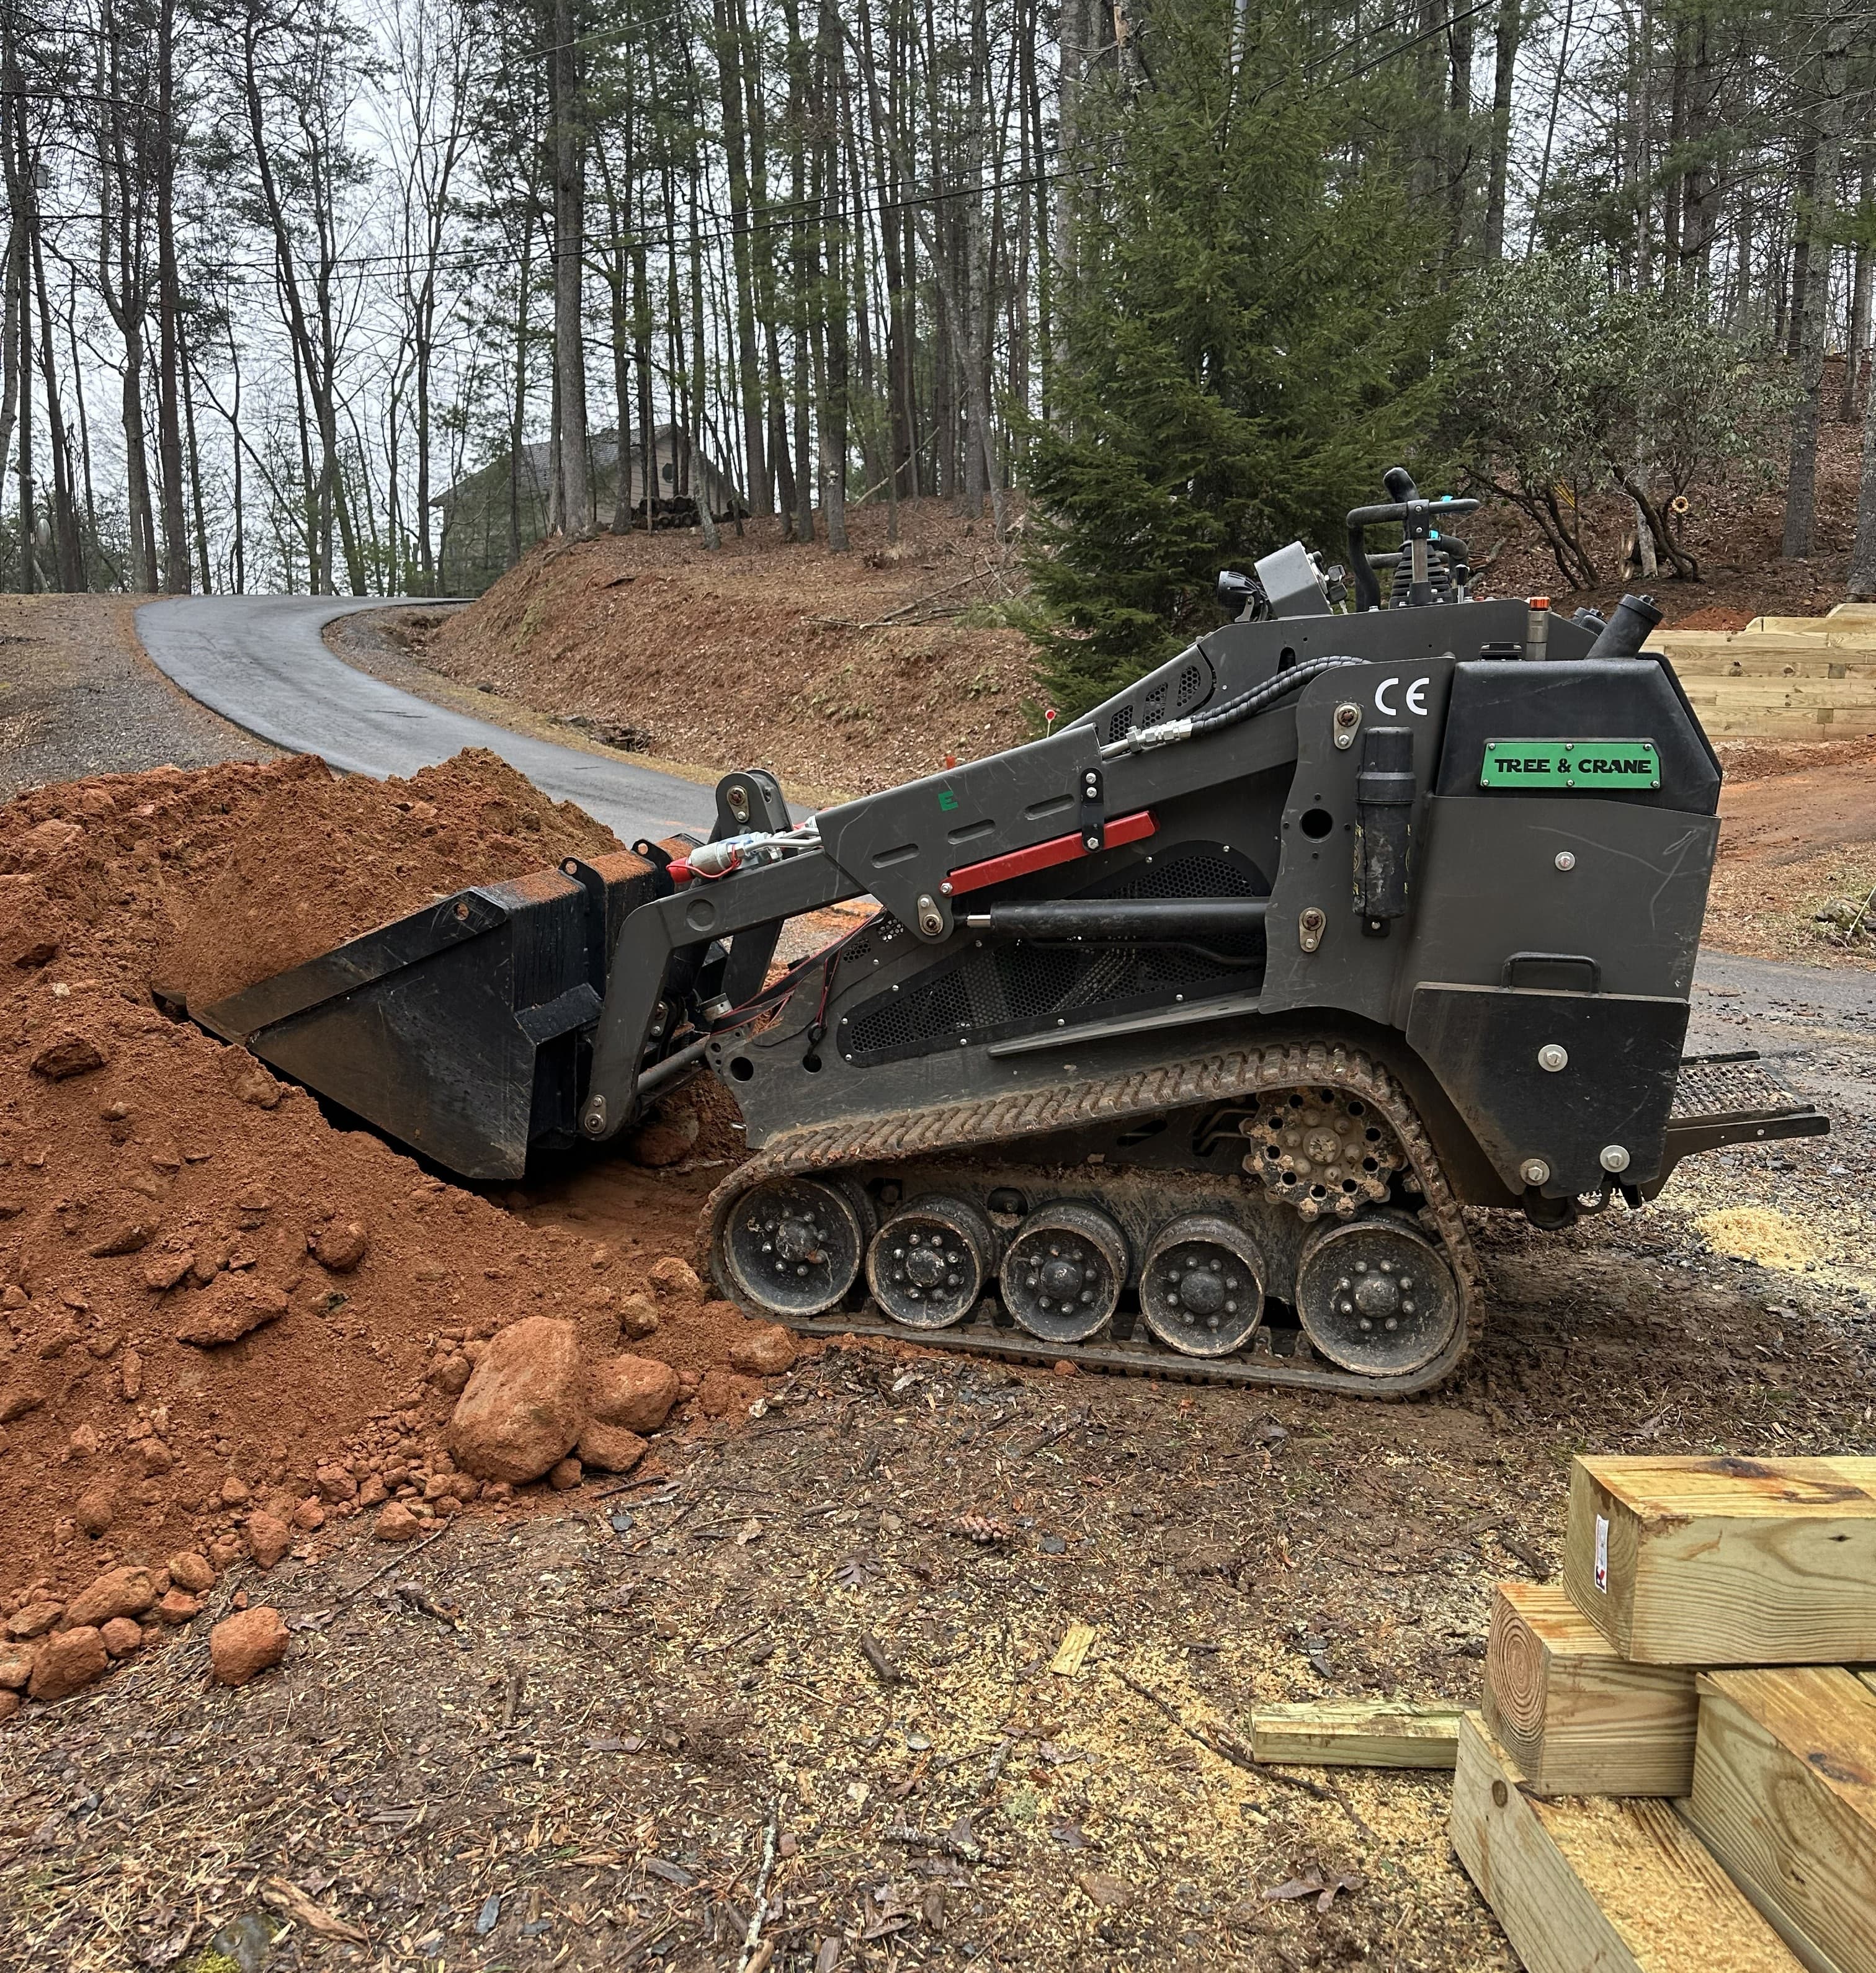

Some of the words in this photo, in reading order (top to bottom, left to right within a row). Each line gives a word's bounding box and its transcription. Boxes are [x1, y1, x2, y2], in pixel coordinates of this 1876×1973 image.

[1375, 677, 1430, 716] CE
[1494, 759, 1551, 773] TREE
[1557, 758, 1571, 773] &
[1578, 759, 1653, 774] CRANE
